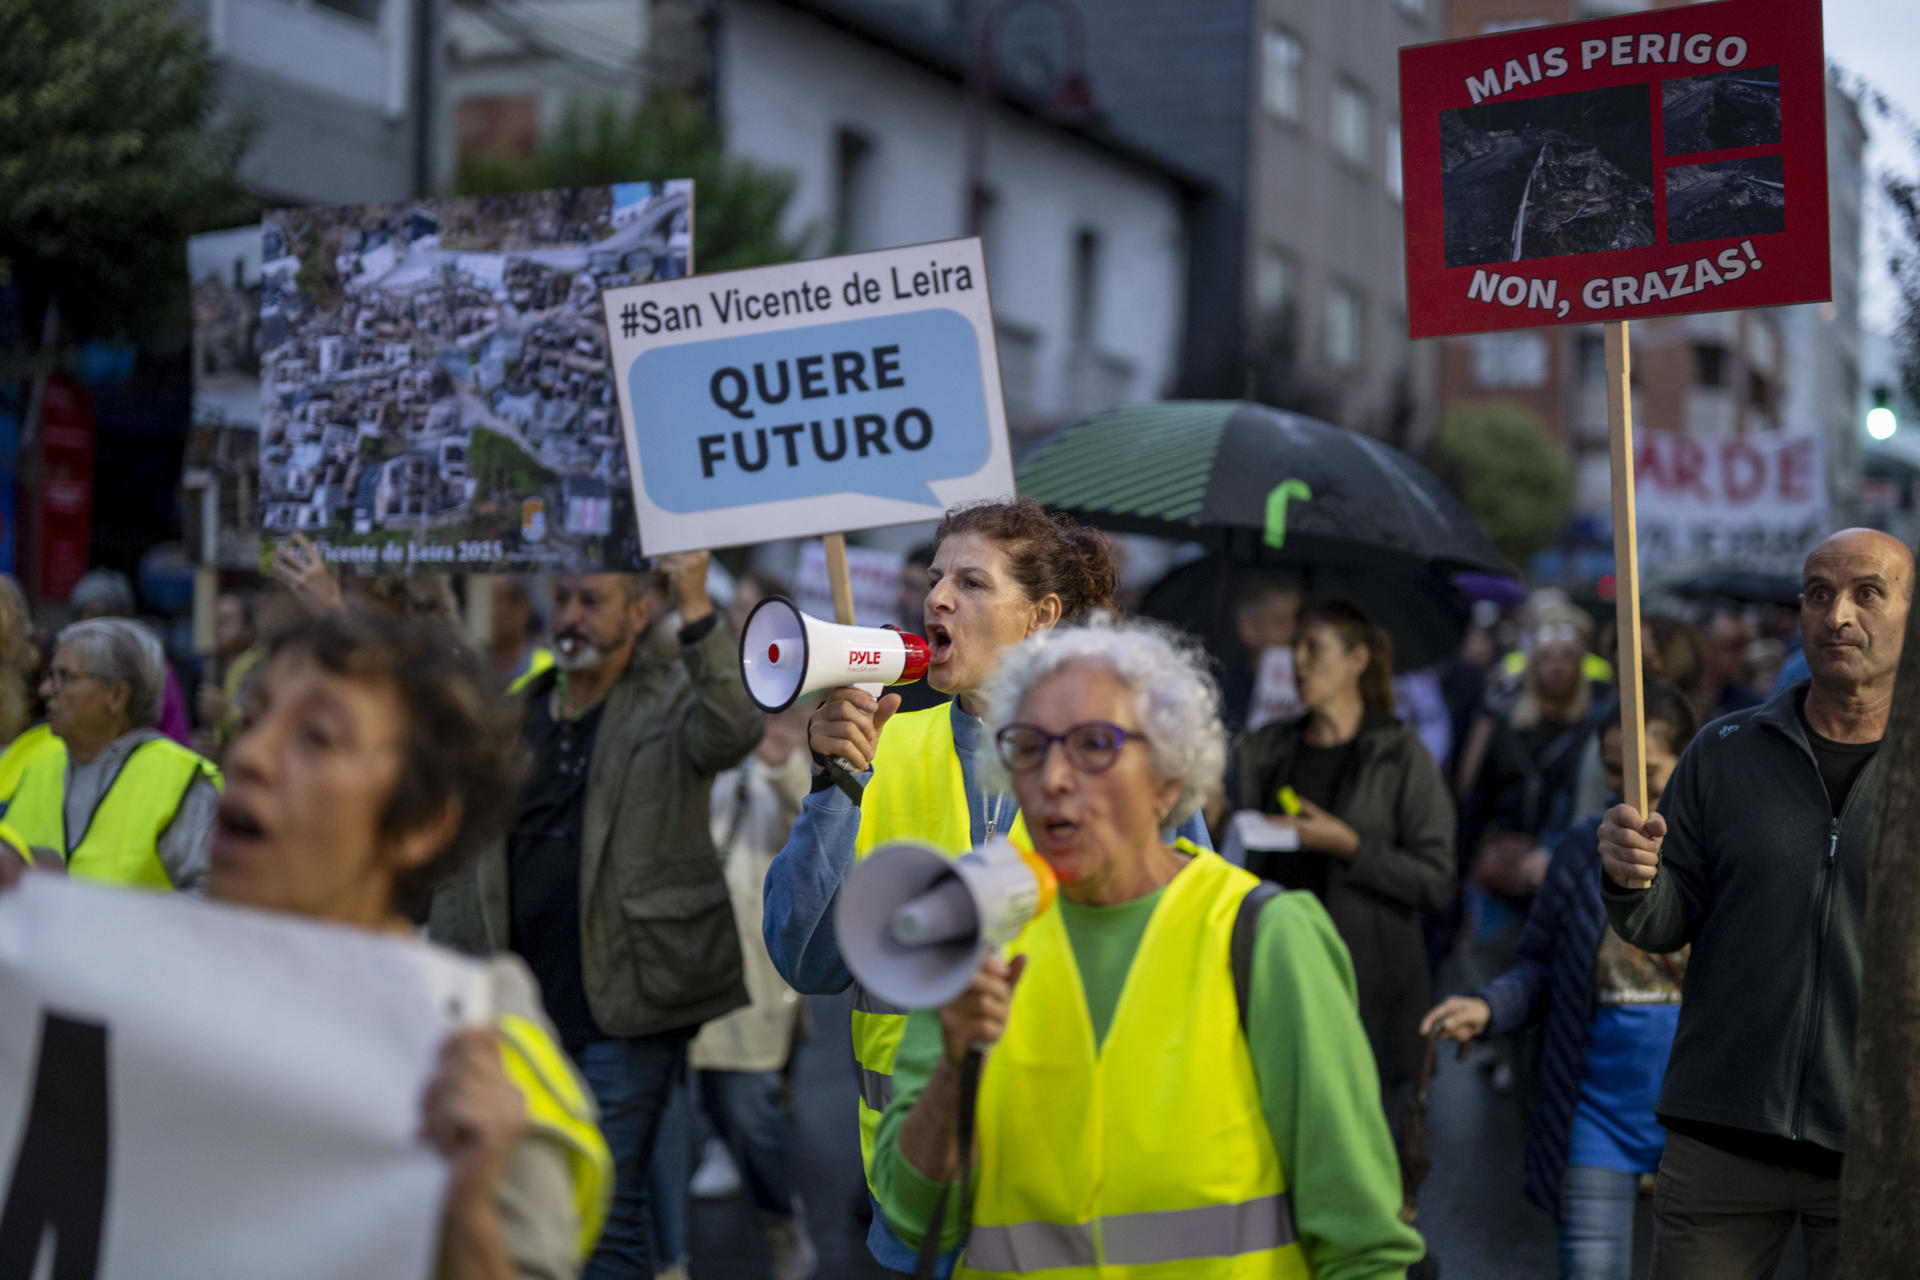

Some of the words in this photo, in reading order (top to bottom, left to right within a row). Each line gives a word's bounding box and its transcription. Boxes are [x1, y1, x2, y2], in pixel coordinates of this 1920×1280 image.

[1464, 45, 1569, 105] MAIS
[1580, 32, 1748, 71] PERIGO
[620, 300, 703, 338] #San
[709, 281, 832, 324] Vicente
[843, 272, 881, 306] de
[890, 261, 974, 301] Leira
[1466, 268, 1571, 318] NON,
[1581, 239, 1763, 310] GRAZAS!
[709, 344, 905, 420] QUERE
[698, 407, 934, 479] FUTURO
[382, 540, 404, 562] de
[408, 540, 455, 562] Leira
[849, 650, 881, 665] PYLE
